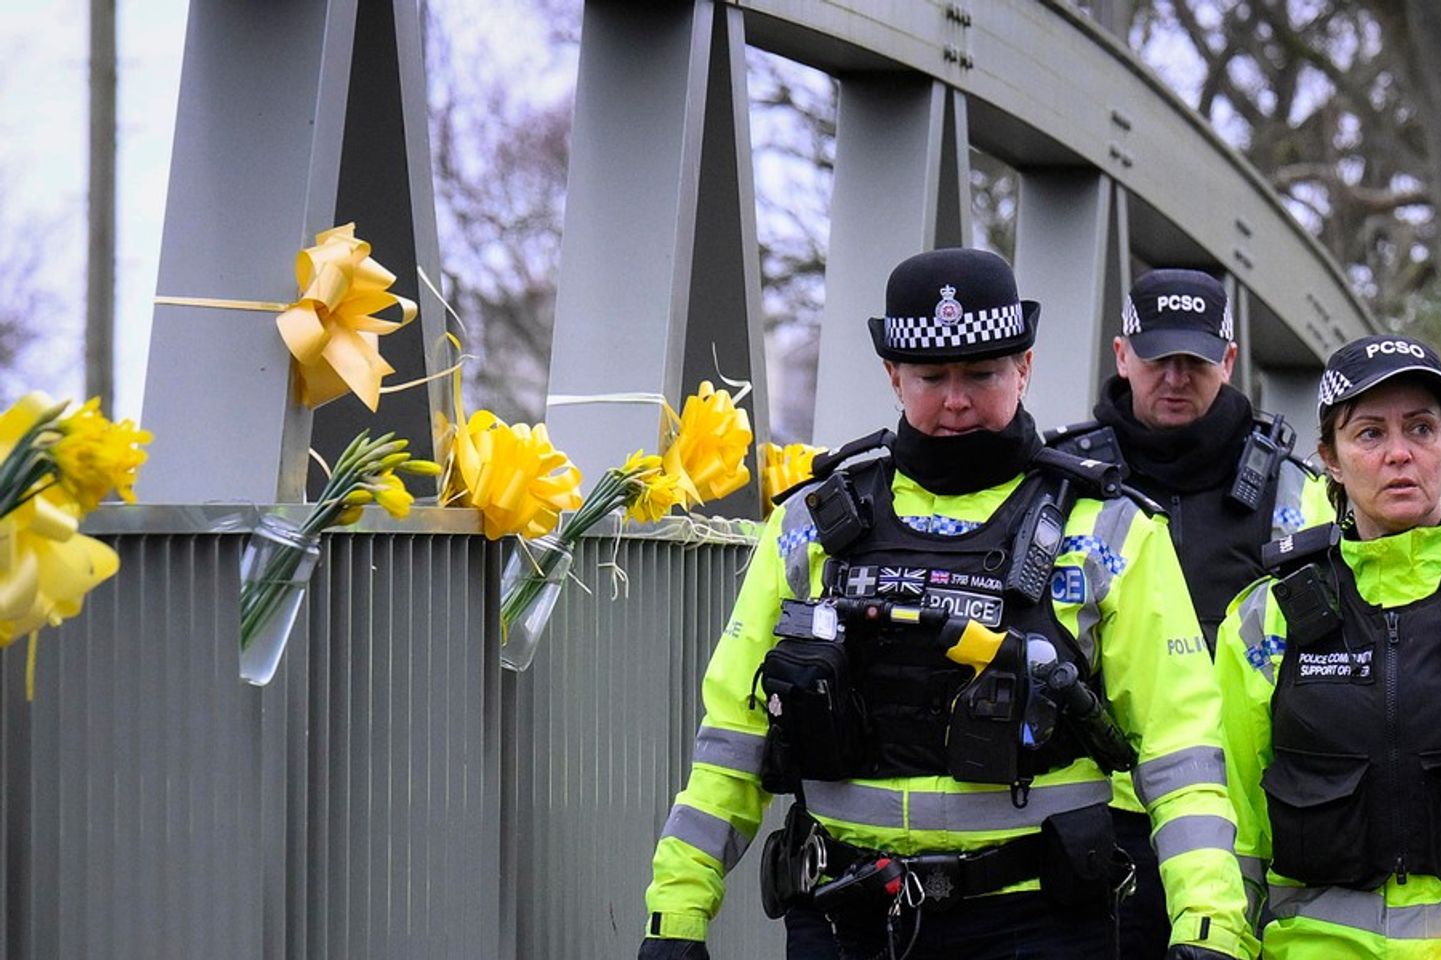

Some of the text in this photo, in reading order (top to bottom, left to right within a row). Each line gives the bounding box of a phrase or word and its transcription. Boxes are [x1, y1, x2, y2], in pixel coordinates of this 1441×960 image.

[1157, 294, 1206, 313] PCSO
[1366, 340, 1425, 359] PCSO
[929, 595, 996, 620] POLICE
[1167, 636, 1207, 656] POLI
[1299, 652, 1328, 664] POLICE
[1300, 664, 1338, 677] SUPPORT
